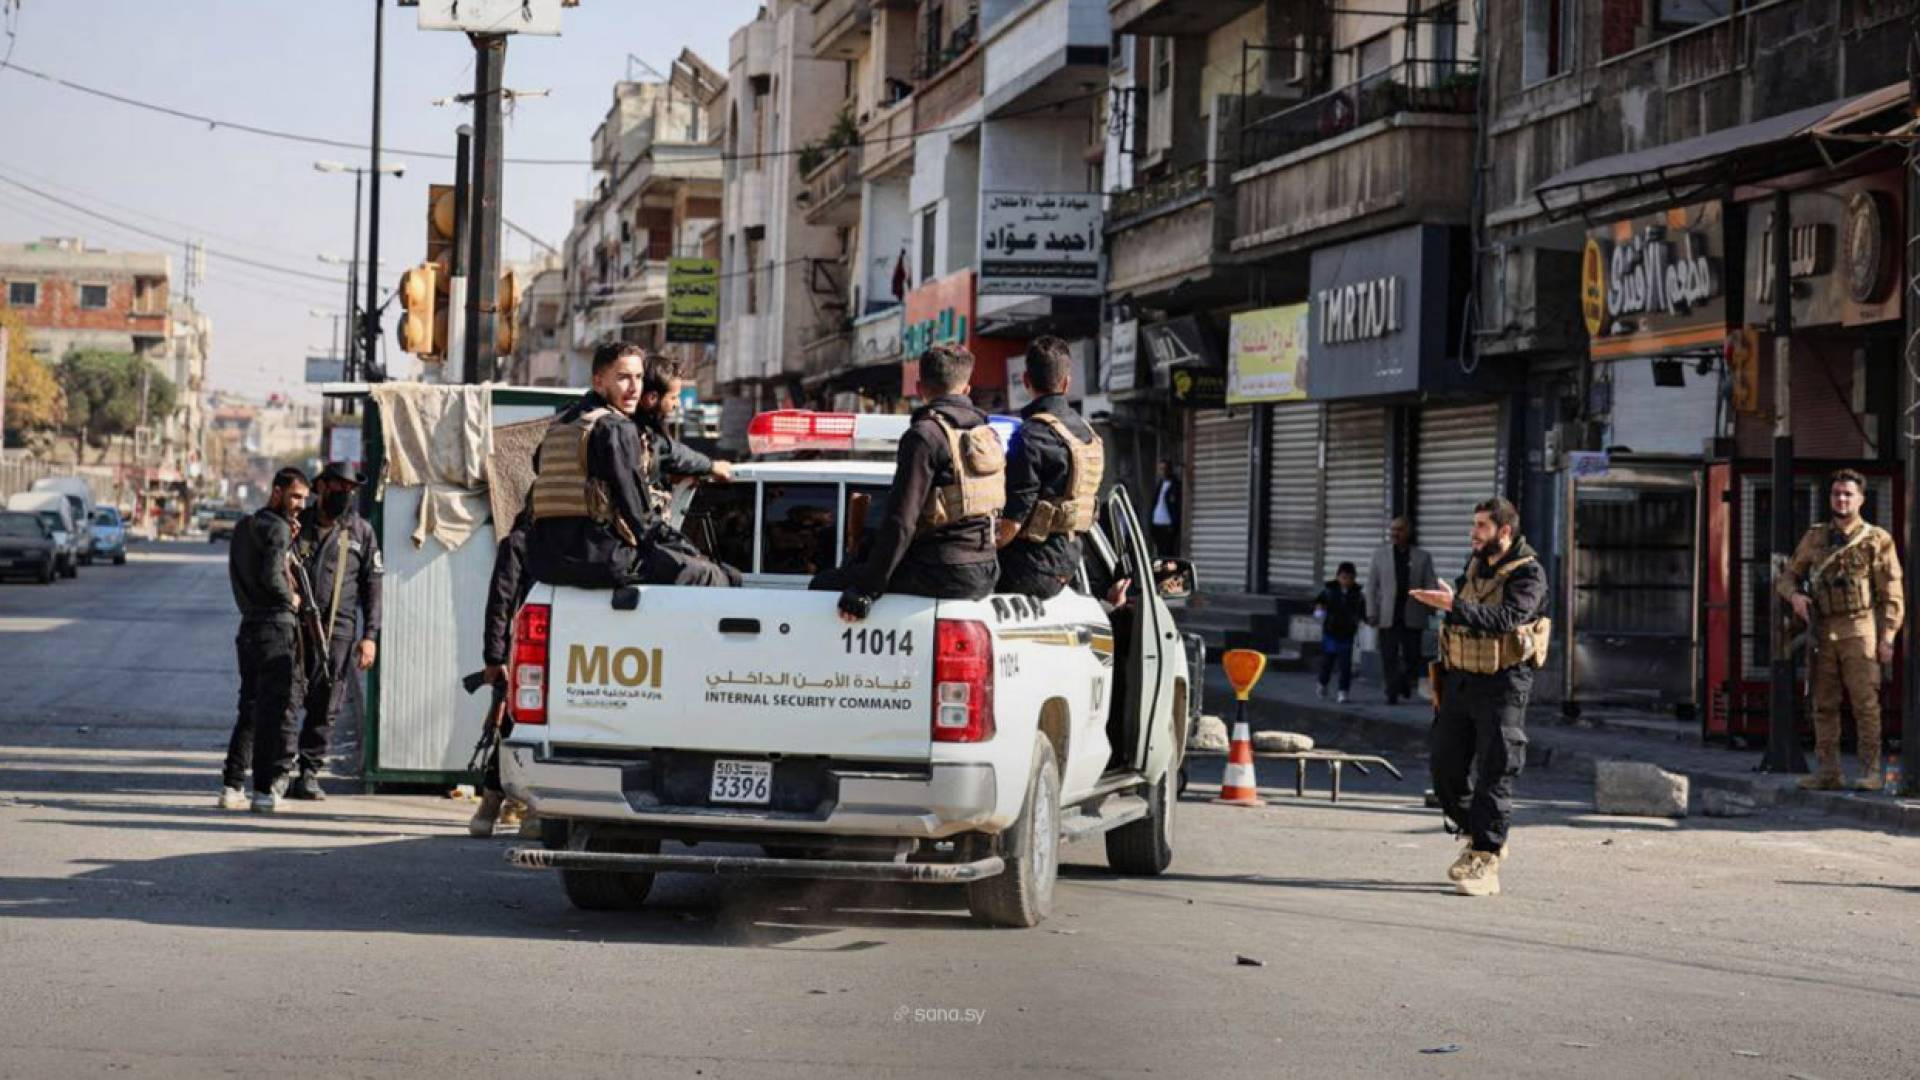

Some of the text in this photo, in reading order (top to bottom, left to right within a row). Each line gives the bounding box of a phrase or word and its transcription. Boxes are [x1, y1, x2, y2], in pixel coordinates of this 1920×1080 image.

[841, 628, 914, 656] 11014
[566, 643, 664, 689] MOI
[705, 669, 912, 693] قيادة الأمن الداخلي
[705, 690, 912, 711] INTERNAL SECURITY COMMAND
[714, 776, 767, 799] 3396
